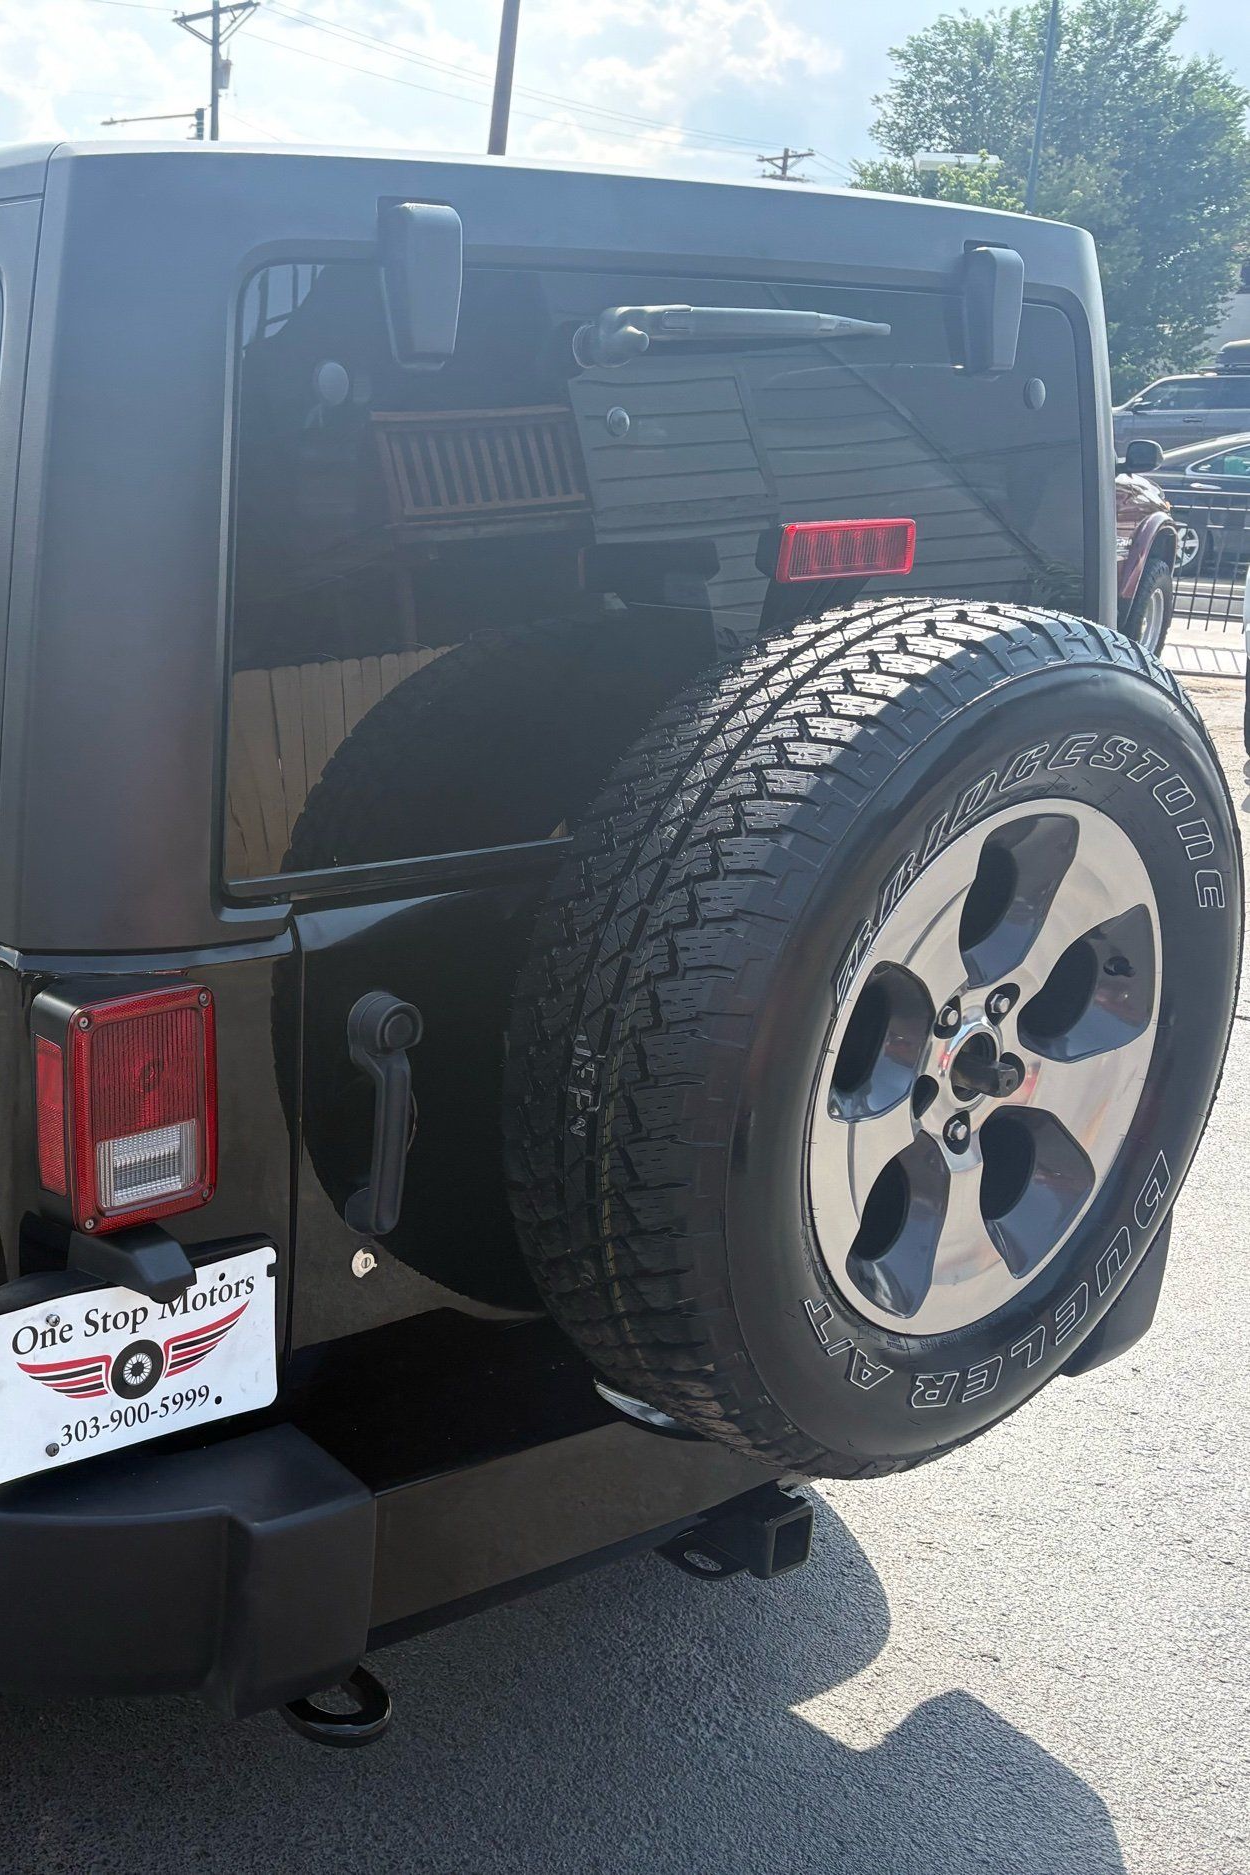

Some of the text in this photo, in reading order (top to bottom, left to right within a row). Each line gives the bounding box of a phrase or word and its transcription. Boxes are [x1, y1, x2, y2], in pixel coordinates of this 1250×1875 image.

[836, 732, 1226, 1004] BRIDGESTONE
[11, 1275, 256, 1356] One Stop Motors
[804, 1149, 1172, 1409] DUELER A/T
[60, 1384, 211, 1448] 303-900-5999
